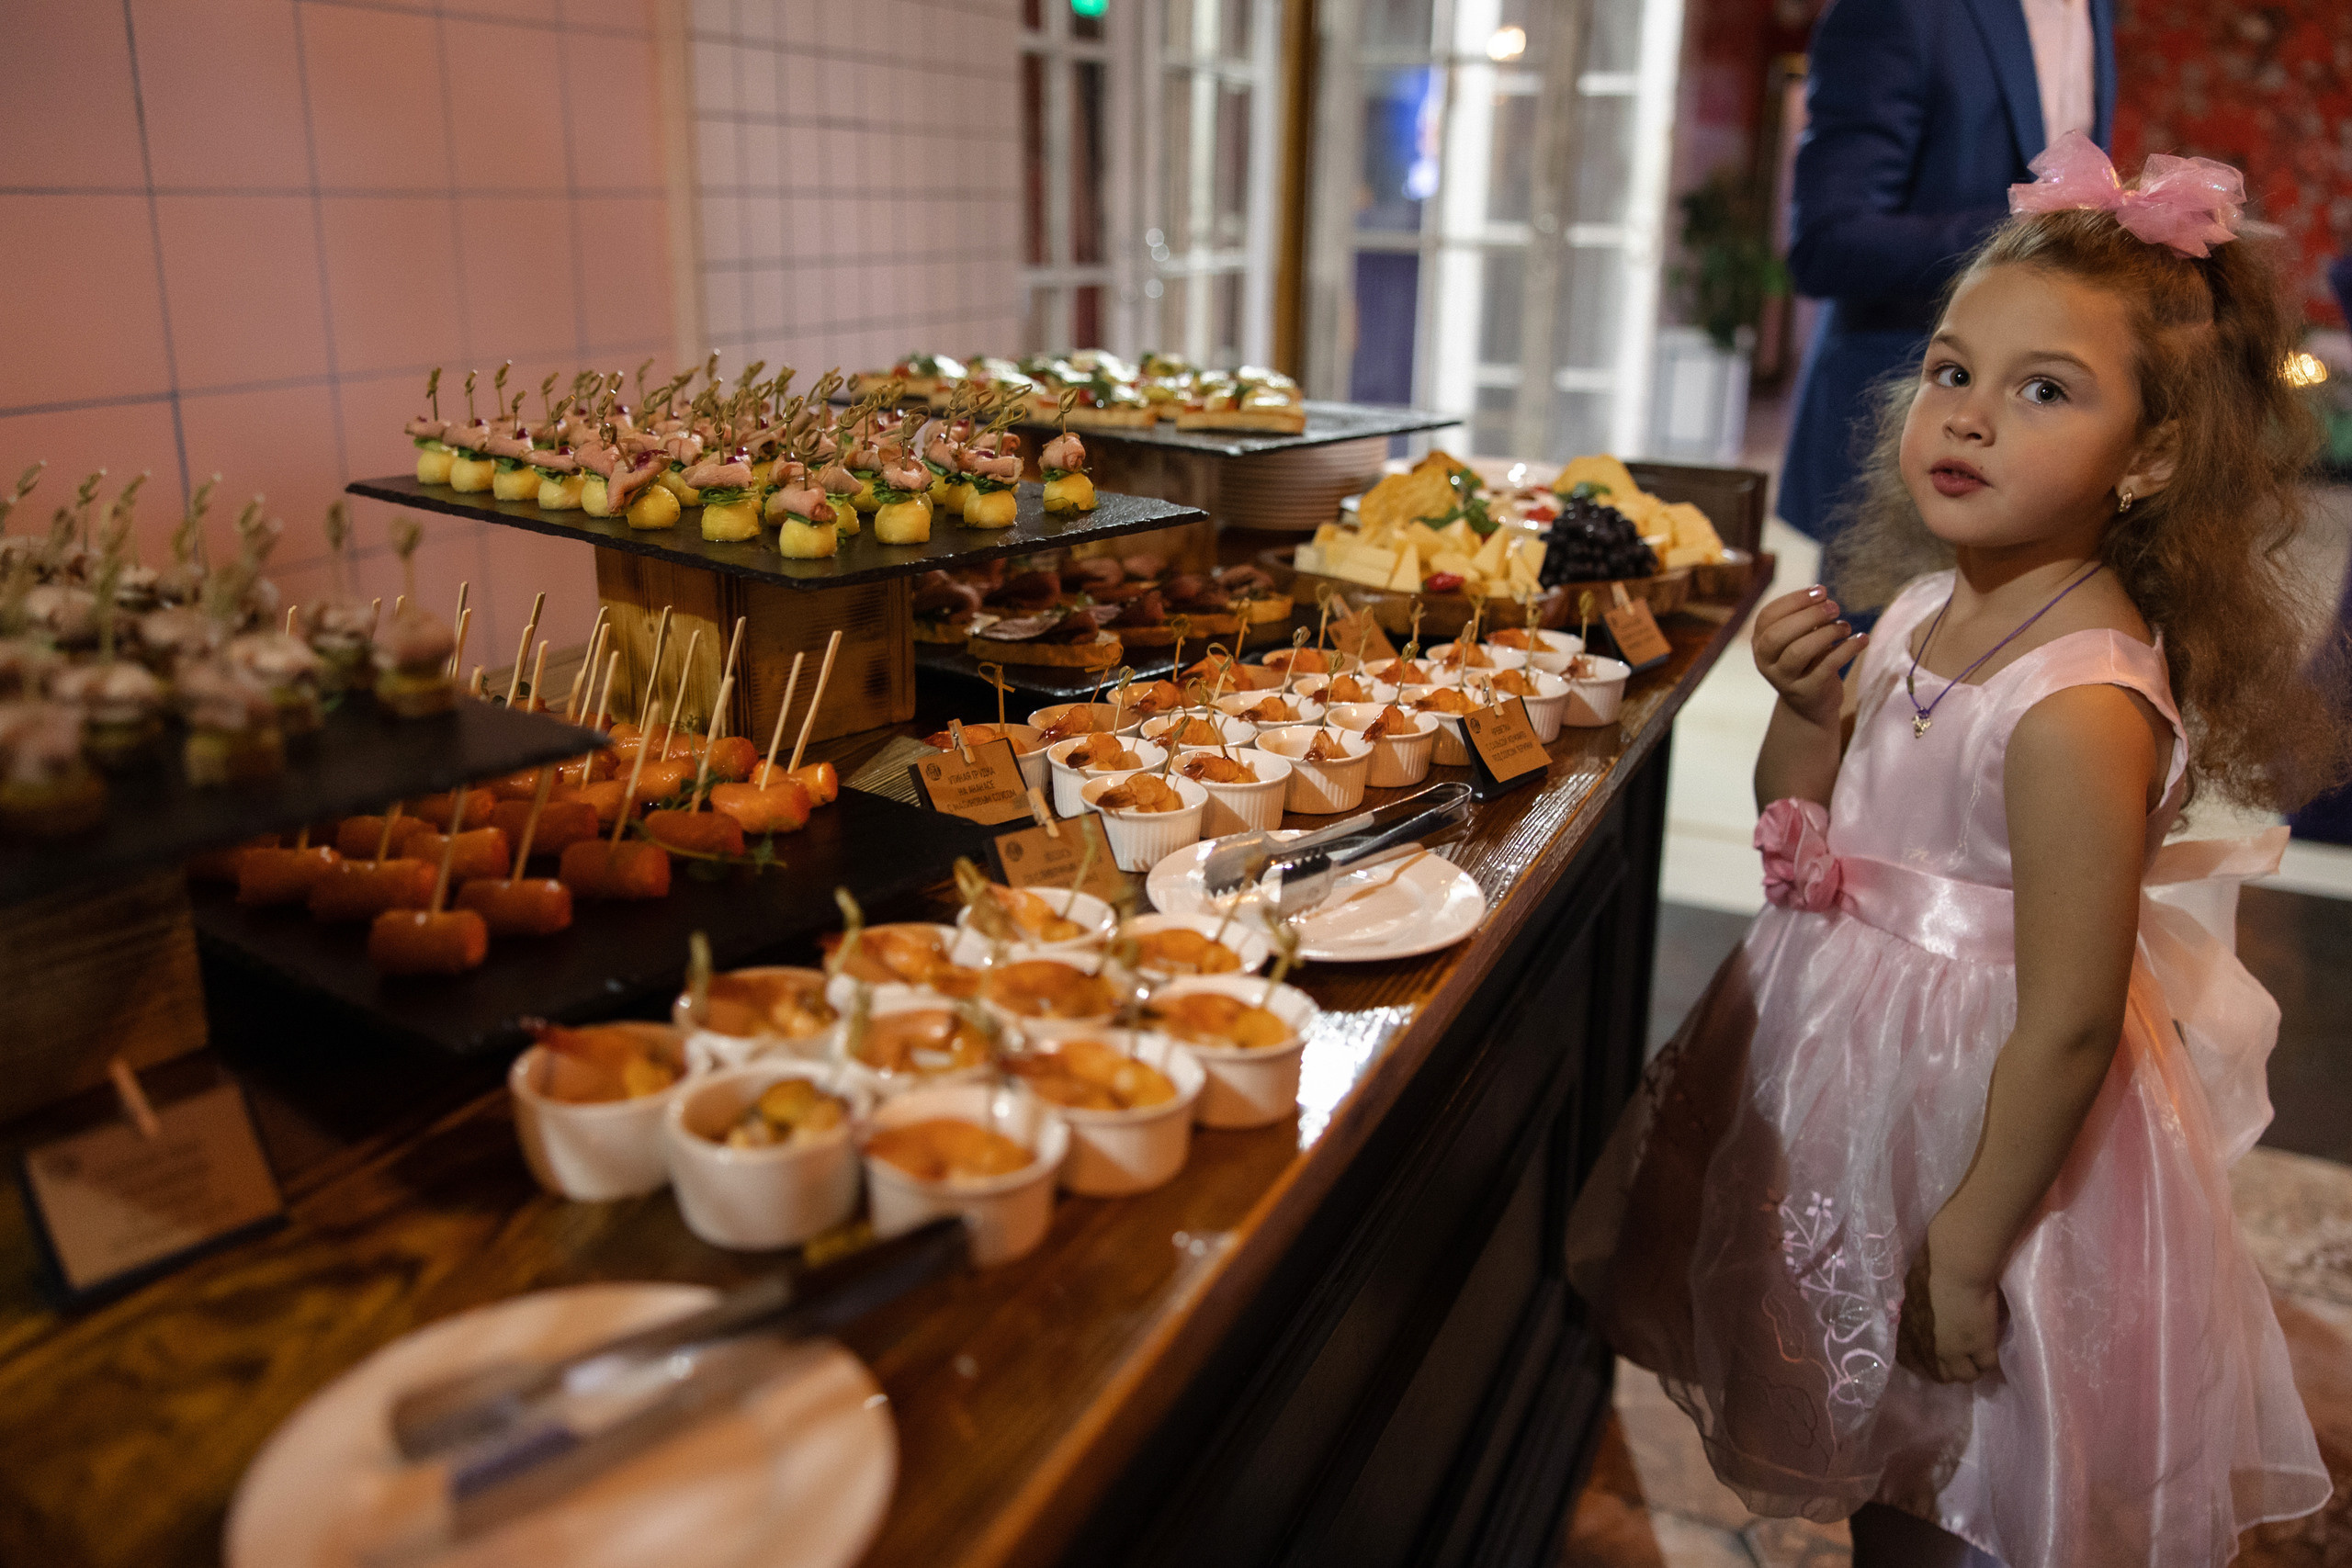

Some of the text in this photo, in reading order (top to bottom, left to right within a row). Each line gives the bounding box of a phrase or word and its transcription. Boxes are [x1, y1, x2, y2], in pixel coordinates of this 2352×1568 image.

[949, 772, 971, 784] УТИНАЯ
[971, 766, 995, 778] ГРУДКА
[957, 780, 996, 796] НА АНАНАСЕ
[946, 788, 1016, 812] С МАЛИНОВЫМ СОУСОМ
